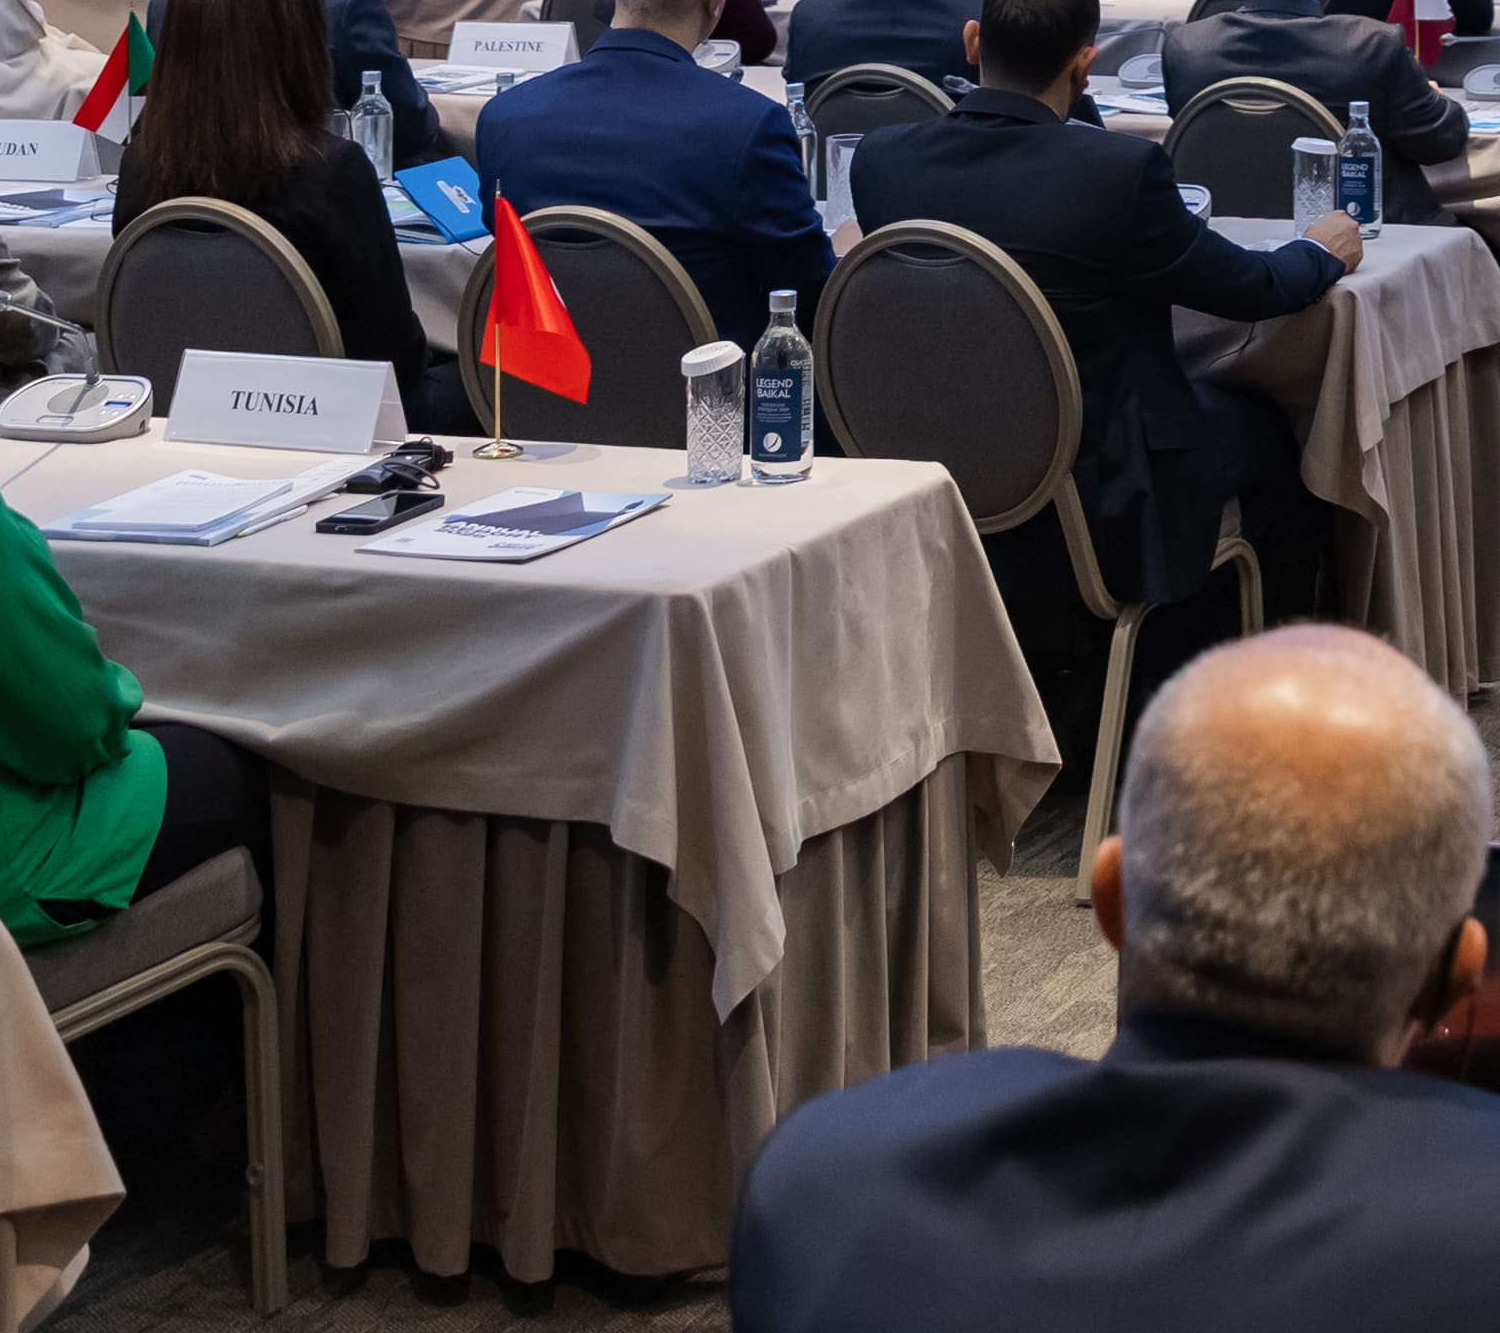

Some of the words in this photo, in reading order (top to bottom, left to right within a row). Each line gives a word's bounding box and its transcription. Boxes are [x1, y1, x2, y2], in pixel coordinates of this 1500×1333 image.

[474, 40, 545, 53] PALESTINE
[1341, 162, 1369, 171] LEGEND
[755, 378, 794, 389] LEGEND
[756, 388, 792, 399] BAIKAL
[231, 390, 318, 415] TUNISIA
